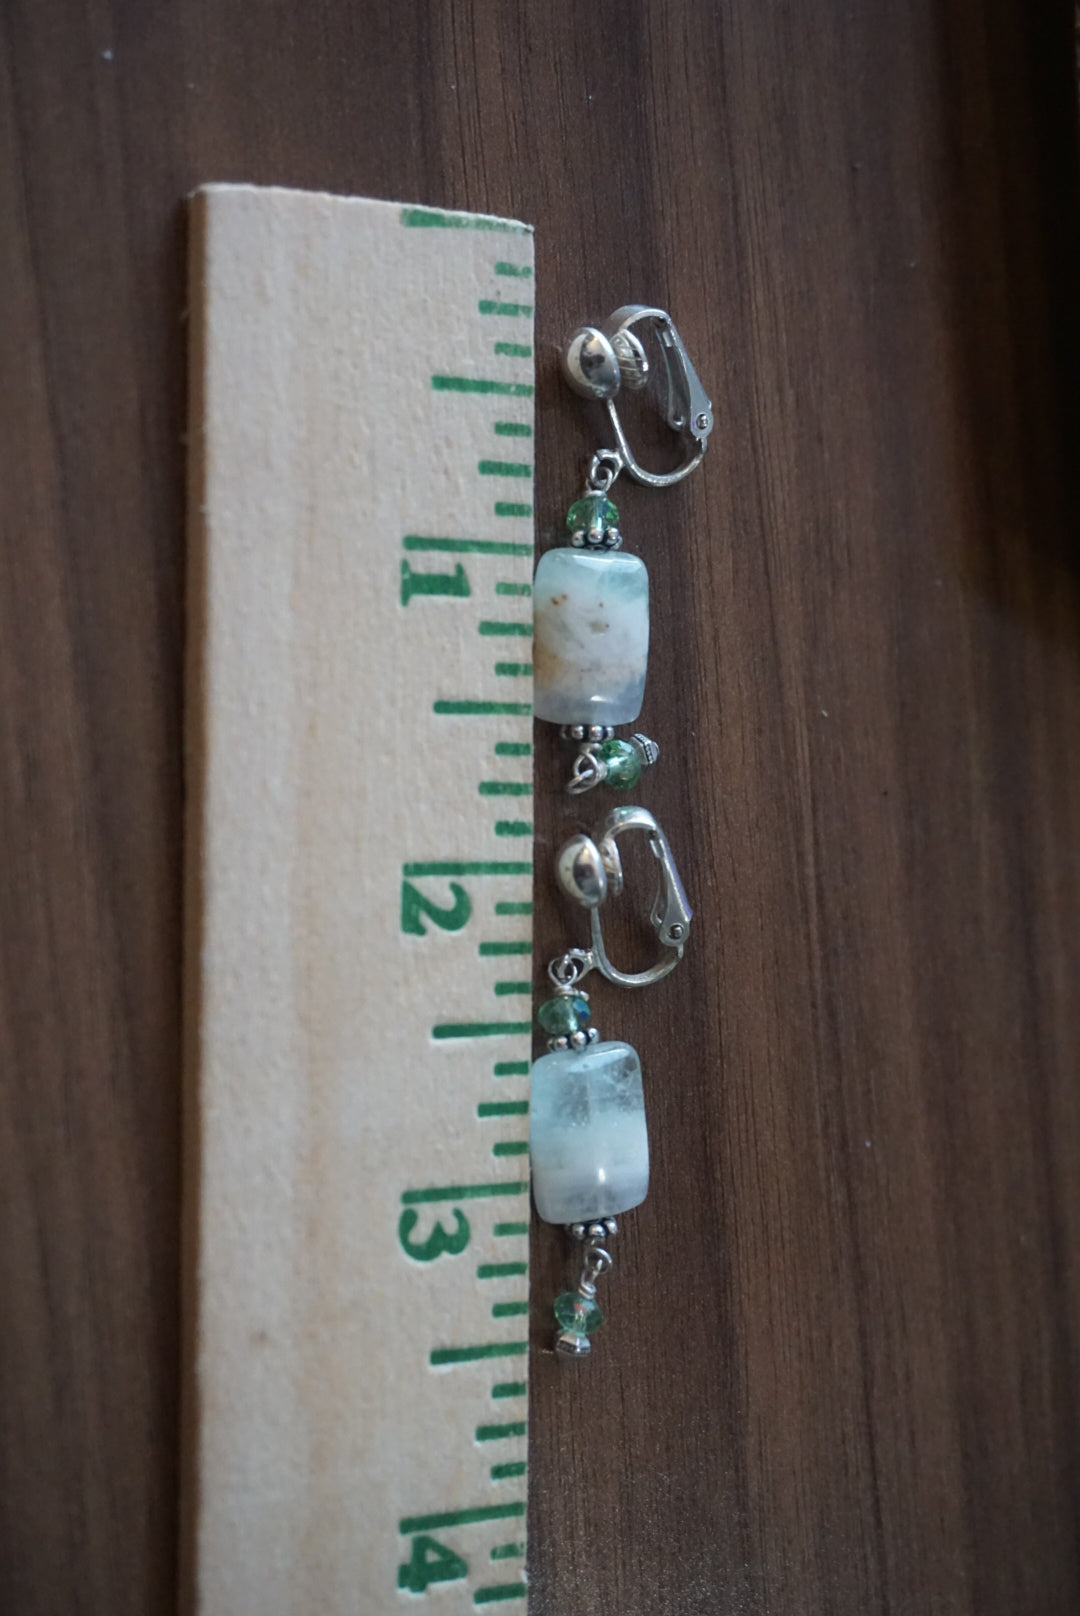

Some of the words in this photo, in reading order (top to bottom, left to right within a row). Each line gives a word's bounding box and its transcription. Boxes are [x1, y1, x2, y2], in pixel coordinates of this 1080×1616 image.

[401, 560, 471, 607] 1
[401, 880, 471, 937] 2
[399, 1206, 470, 1262] 3
[397, 1534, 468, 1595] 4
